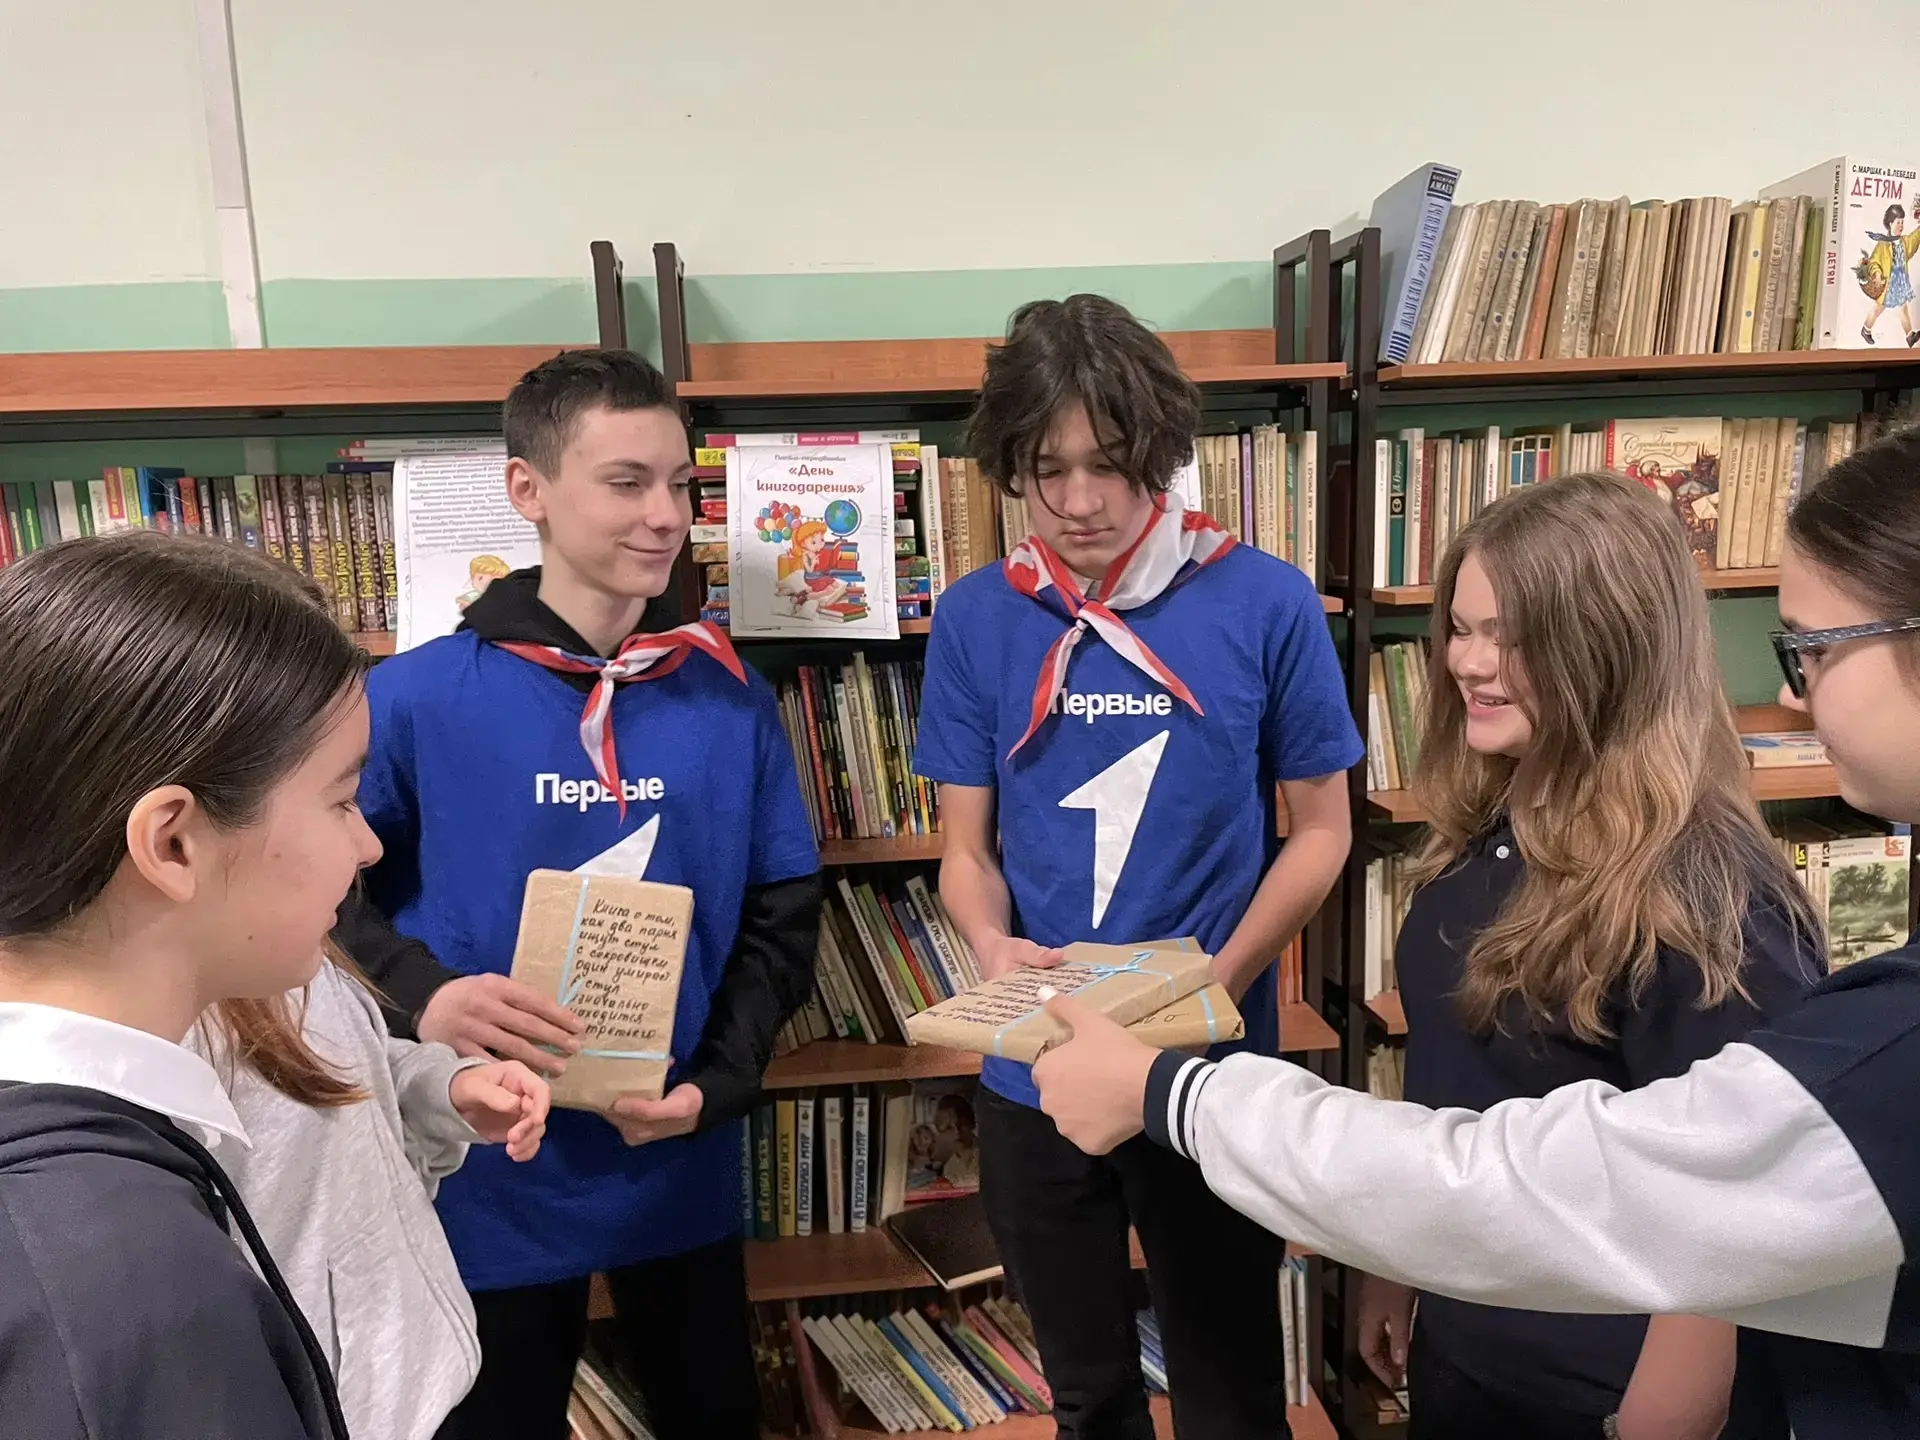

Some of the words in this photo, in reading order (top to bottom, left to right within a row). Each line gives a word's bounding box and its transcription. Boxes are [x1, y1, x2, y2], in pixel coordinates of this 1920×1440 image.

[1850, 177, 1904, 200] ДЕТЯМ
[1417, 202, 1445, 264] МОСКВЫ
[1826, 251, 1837, 286] ДЕТЯМ
[788, 463, 834, 477] «День
[756, 478, 866, 495] книгодарения»
[1051, 687, 1173, 725] Первые
[593, 898, 629, 918] Книга
[634, 911, 642, 919] о
[580, 916, 603, 928] как
[610, 920, 632, 935] два
[585, 980, 620, 996] стул
[780, 1132, 790, 1161] ВСЕХ
[801, 1132, 810, 1159] МИР
[855, 1130, 866, 1157] МИР
[781, 1166, 790, 1192] ОБО
[799, 1162, 810, 1211] ПОЗНАЮ
[854, 1159, 865, 1209] ПОЗНАЮ
